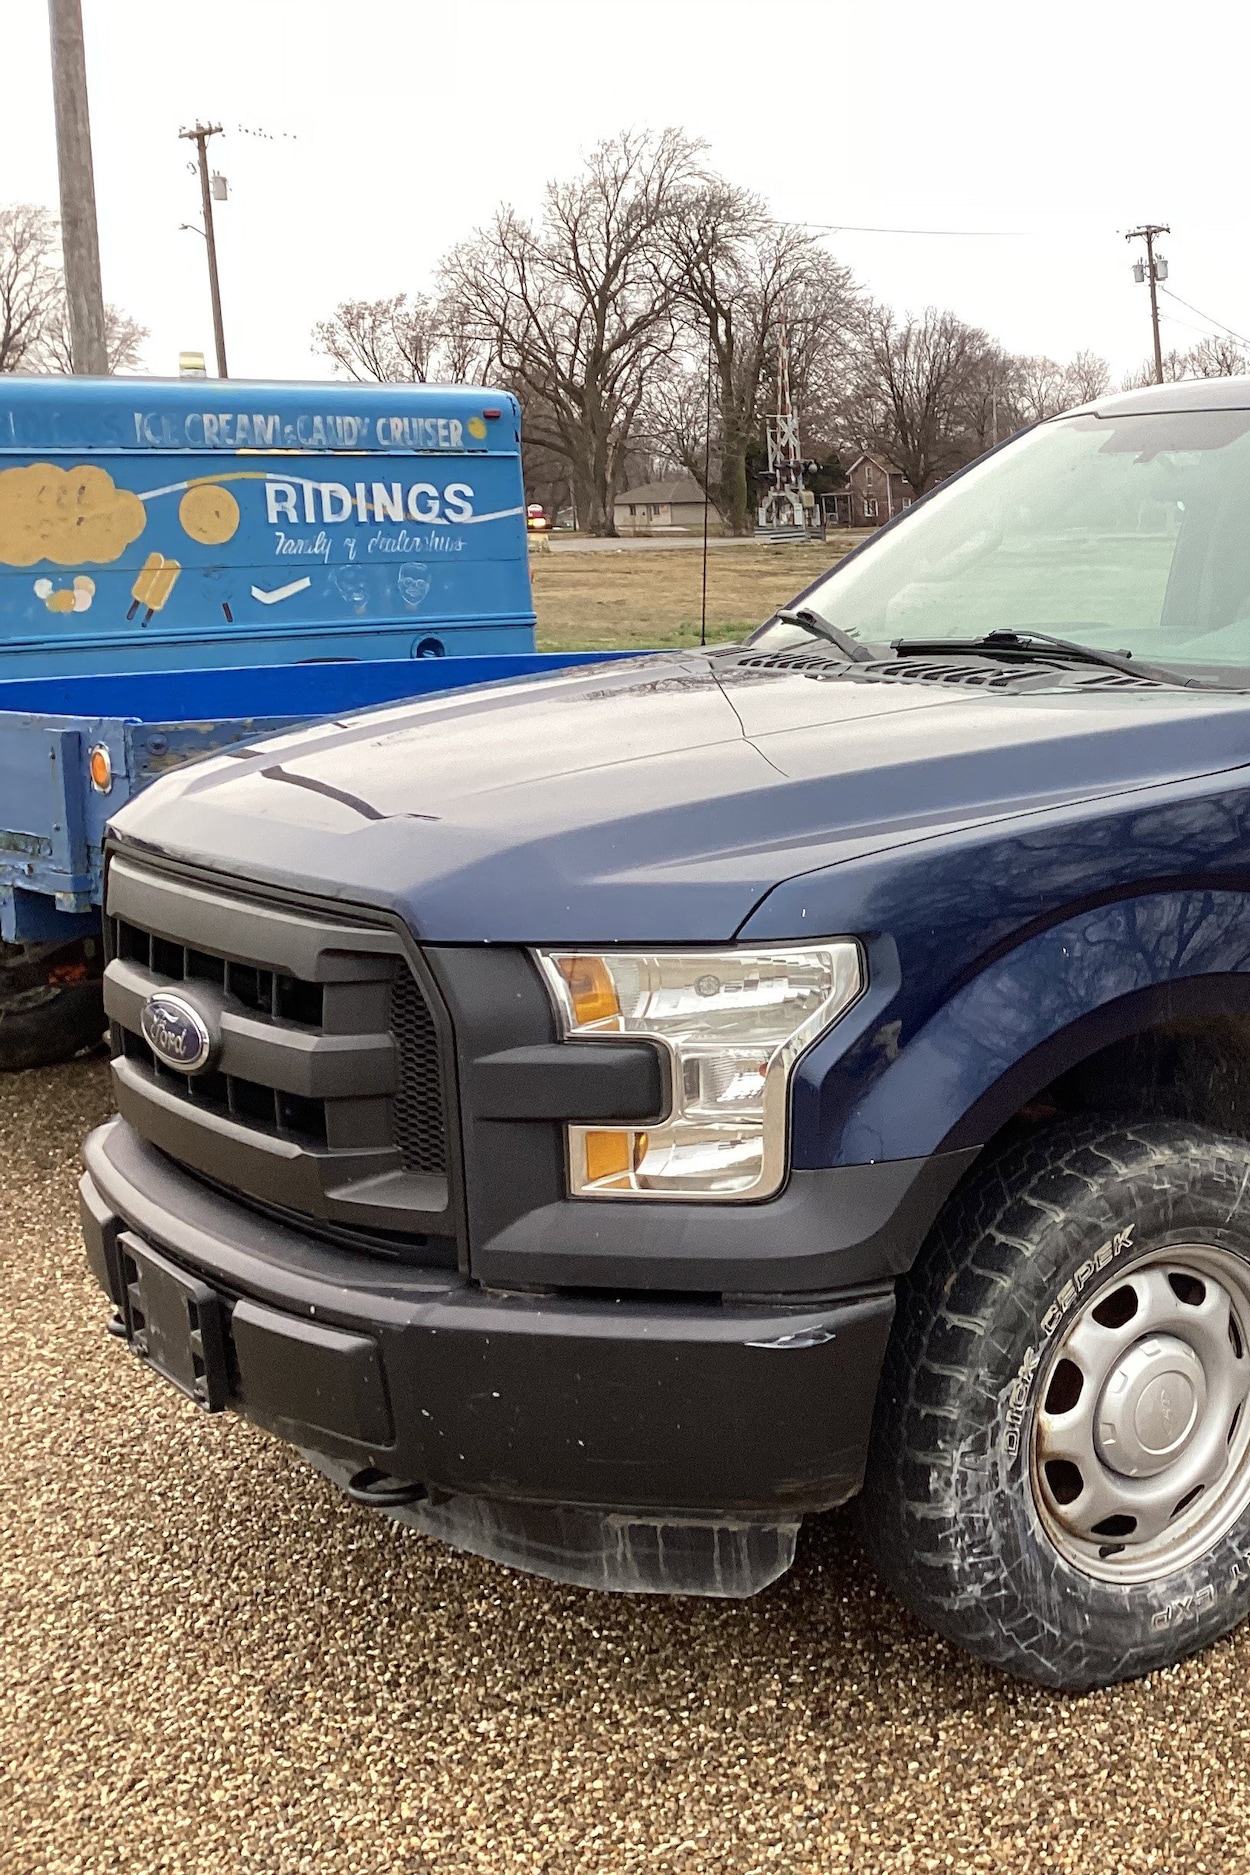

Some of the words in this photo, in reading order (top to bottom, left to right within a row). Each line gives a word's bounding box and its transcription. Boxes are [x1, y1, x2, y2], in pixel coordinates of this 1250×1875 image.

[184, 412, 282, 445] CREAM
[376, 416, 464, 448] CRUISER
[265, 482, 475, 524] RIDINGS
[275, 530, 333, 564] Family
[150, 1008, 187, 1056] Ford
[1003, 1346, 1040, 1456] DICK
[1040, 1223, 1136, 1336] CEPEK
